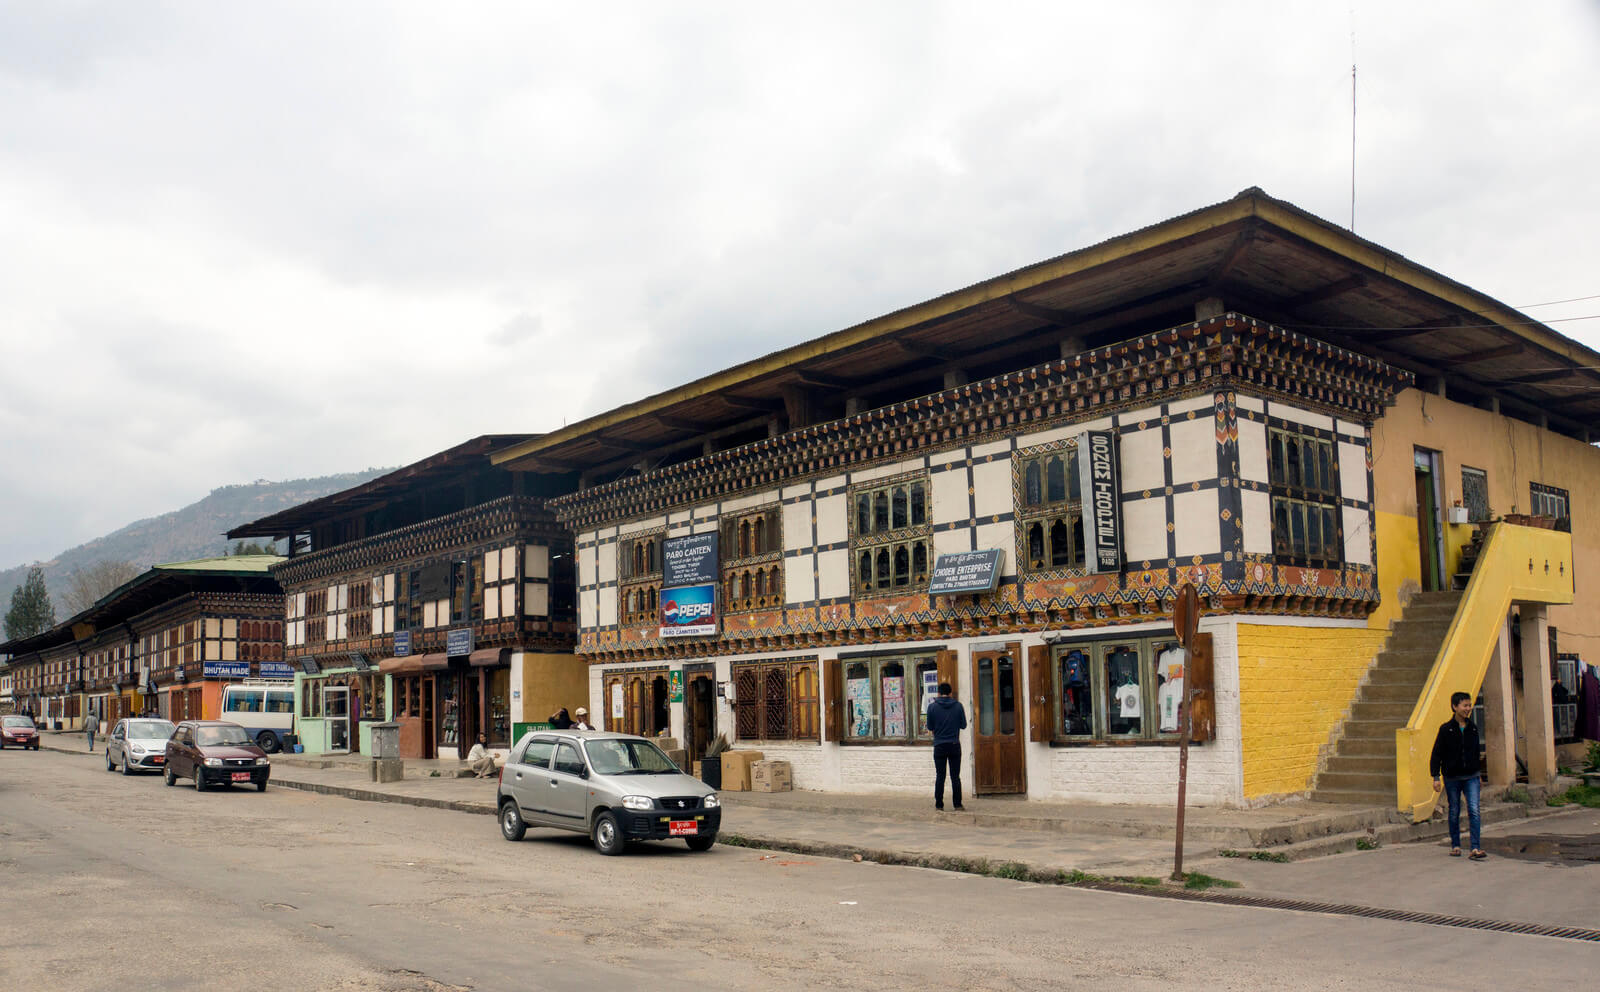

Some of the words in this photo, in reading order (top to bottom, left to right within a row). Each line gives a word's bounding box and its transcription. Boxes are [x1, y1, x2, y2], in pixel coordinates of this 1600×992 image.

[1091, 435, 1111, 480] SONAM
[1095, 482, 1115, 546] TROPHEL
[665, 550, 683, 560] PARO
[684, 546, 711, 557] CANTEEN
[957, 563, 992, 575] ENTERPRISE
[679, 603, 712, 616] PEPSI
[204, 666, 230, 674] BHUTAN
[231, 667, 249, 675] MADE
[260, 663, 275, 671] BHUTAN
